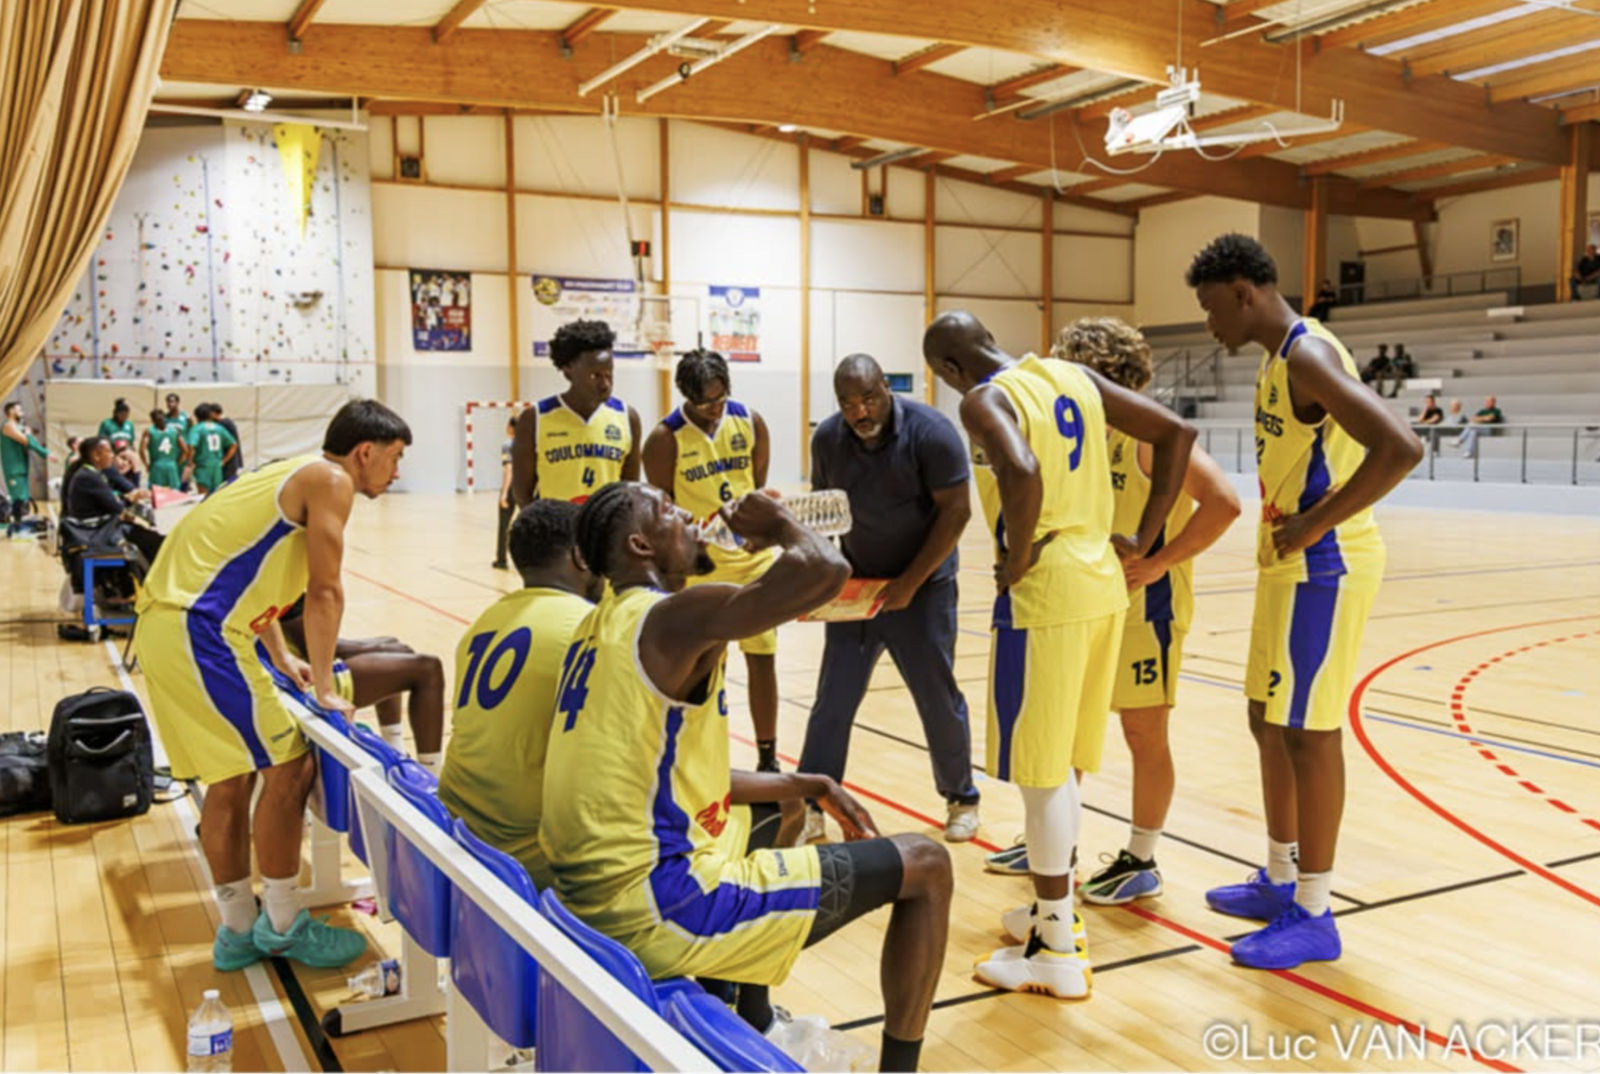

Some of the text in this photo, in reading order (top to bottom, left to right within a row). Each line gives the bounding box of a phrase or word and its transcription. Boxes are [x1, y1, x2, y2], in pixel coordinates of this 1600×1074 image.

[158, 437, 172, 455] 4
[1053, 393, 1085, 473] 9
[582, 466, 596, 488] 4
[718, 481, 733, 502] 6
[457, 626, 532, 711] 10
[1131, 657, 1158, 686] 13
[553, 638, 598, 734] 14
